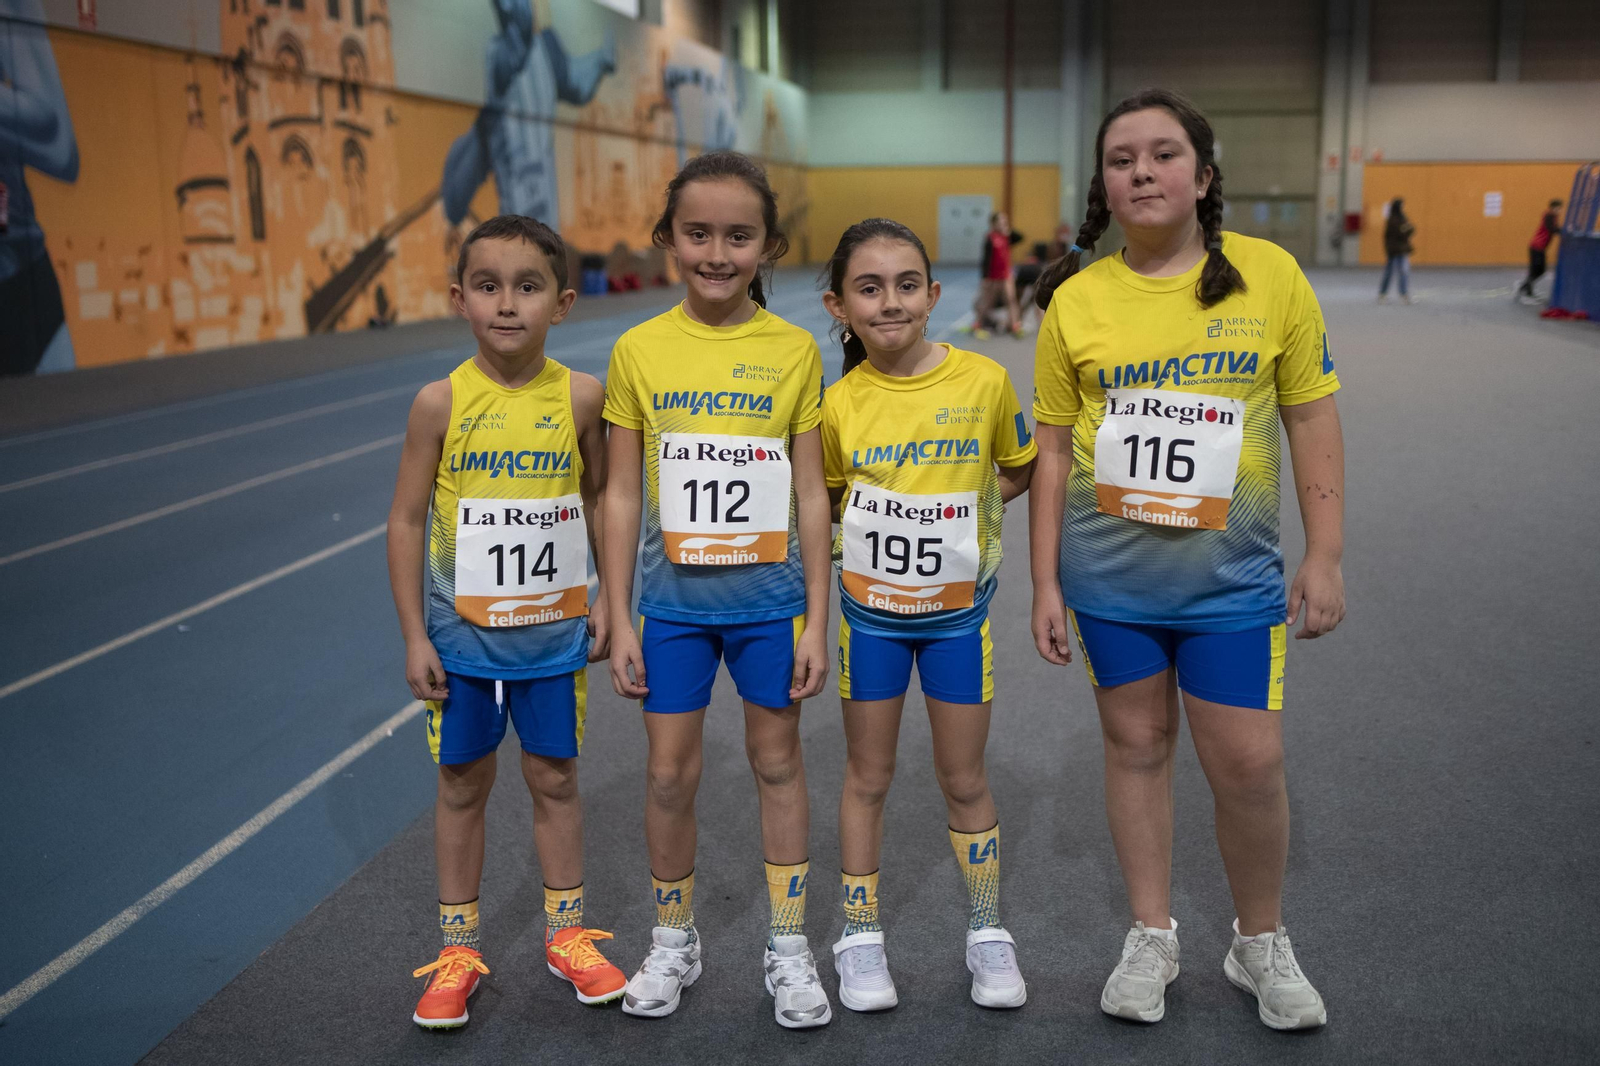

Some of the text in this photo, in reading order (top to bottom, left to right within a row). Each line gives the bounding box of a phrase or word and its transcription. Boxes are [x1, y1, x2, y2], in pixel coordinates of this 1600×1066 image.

[1225, 317, 1267, 328] ARRANZ
[1225, 328, 1266, 339] DENTAL
[746, 365, 784, 375] ARRANZ
[746, 372, 782, 383] DENTAL
[1098, 351, 1259, 389] LIMIACTIVA
[1182, 377, 1224, 386] ASOCIACIÓN
[653, 391, 773, 416] LIMIACTIVA
[950, 406, 987, 415] ARRANZ
[1109, 397, 1235, 426] La Región
[471, 422, 507, 431] DENTAL
[472, 412, 508, 422] ARRANZ
[535, 422, 560, 430] amura
[950, 415, 986, 424] DENTAL
[1014, 411, 1032, 448] L
[451, 450, 571, 479] LIMIACTIVA
[661, 441, 783, 467] La Región
[852, 438, 980, 468] LIMIACTIVA
[1123, 434, 1196, 484] 116
[683, 479, 750, 523] 112
[851, 489, 970, 526] La Región
[462, 505, 580, 530] La Región
[1121, 504, 1199, 528] telemiño
[488, 541, 558, 586] 114
[680, 549, 759, 565] telemiño
[865, 530, 943, 577] 195
[867, 593, 944, 614] telemiño
[488, 607, 564, 627] telemiño
[969, 836, 997, 864] LA
[656, 887, 682, 905] LA
[845, 884, 867, 906] LA
